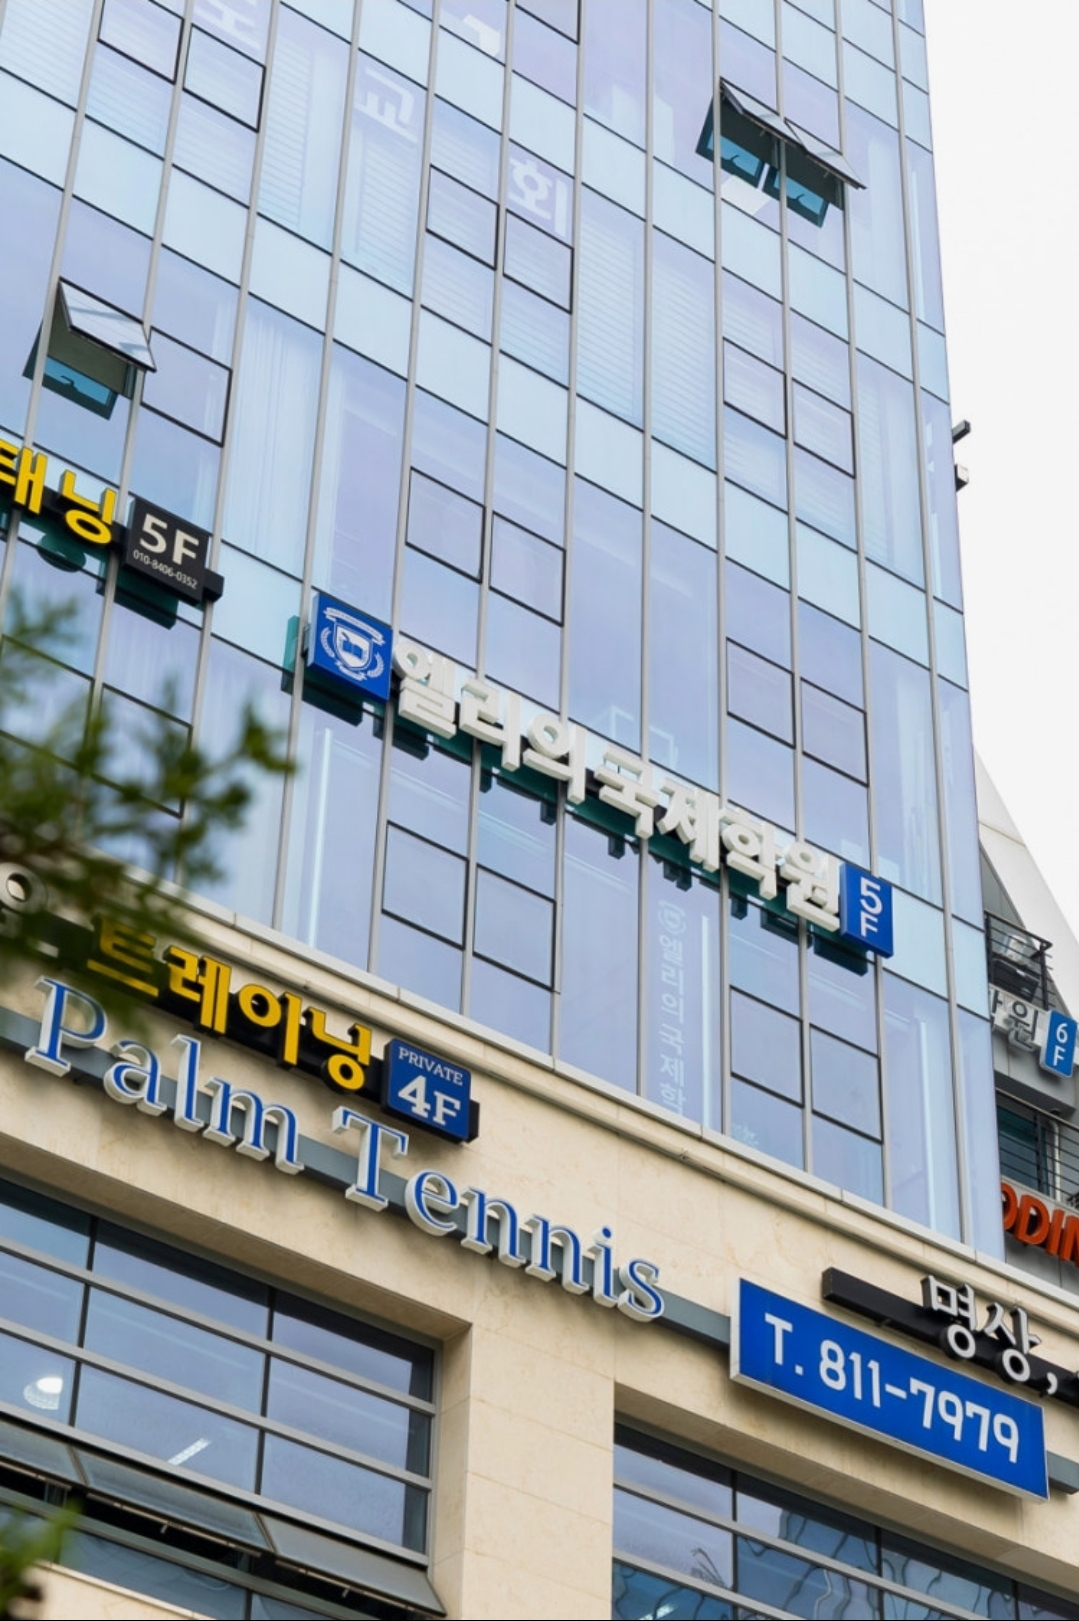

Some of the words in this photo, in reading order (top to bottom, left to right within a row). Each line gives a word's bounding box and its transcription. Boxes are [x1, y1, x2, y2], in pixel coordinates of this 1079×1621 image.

[0, 439, 117, 544] 태닝
[139, 513, 200, 566] 5F
[133, 549, 198, 590] 010-8406-0352
[392, 640, 840, 932] 엘리의국제학원
[87, 914, 372, 1091] 트레이닝
[397, 1075, 461, 1126] 4F
[398, 1046, 463, 1087] PRIVATE
[24, 975, 304, 1175] Palm
[332, 1106, 665, 1322] Tennis
[765, 1313, 803, 1376] T.
[819, 1340, 1019, 1463] 811-7979
